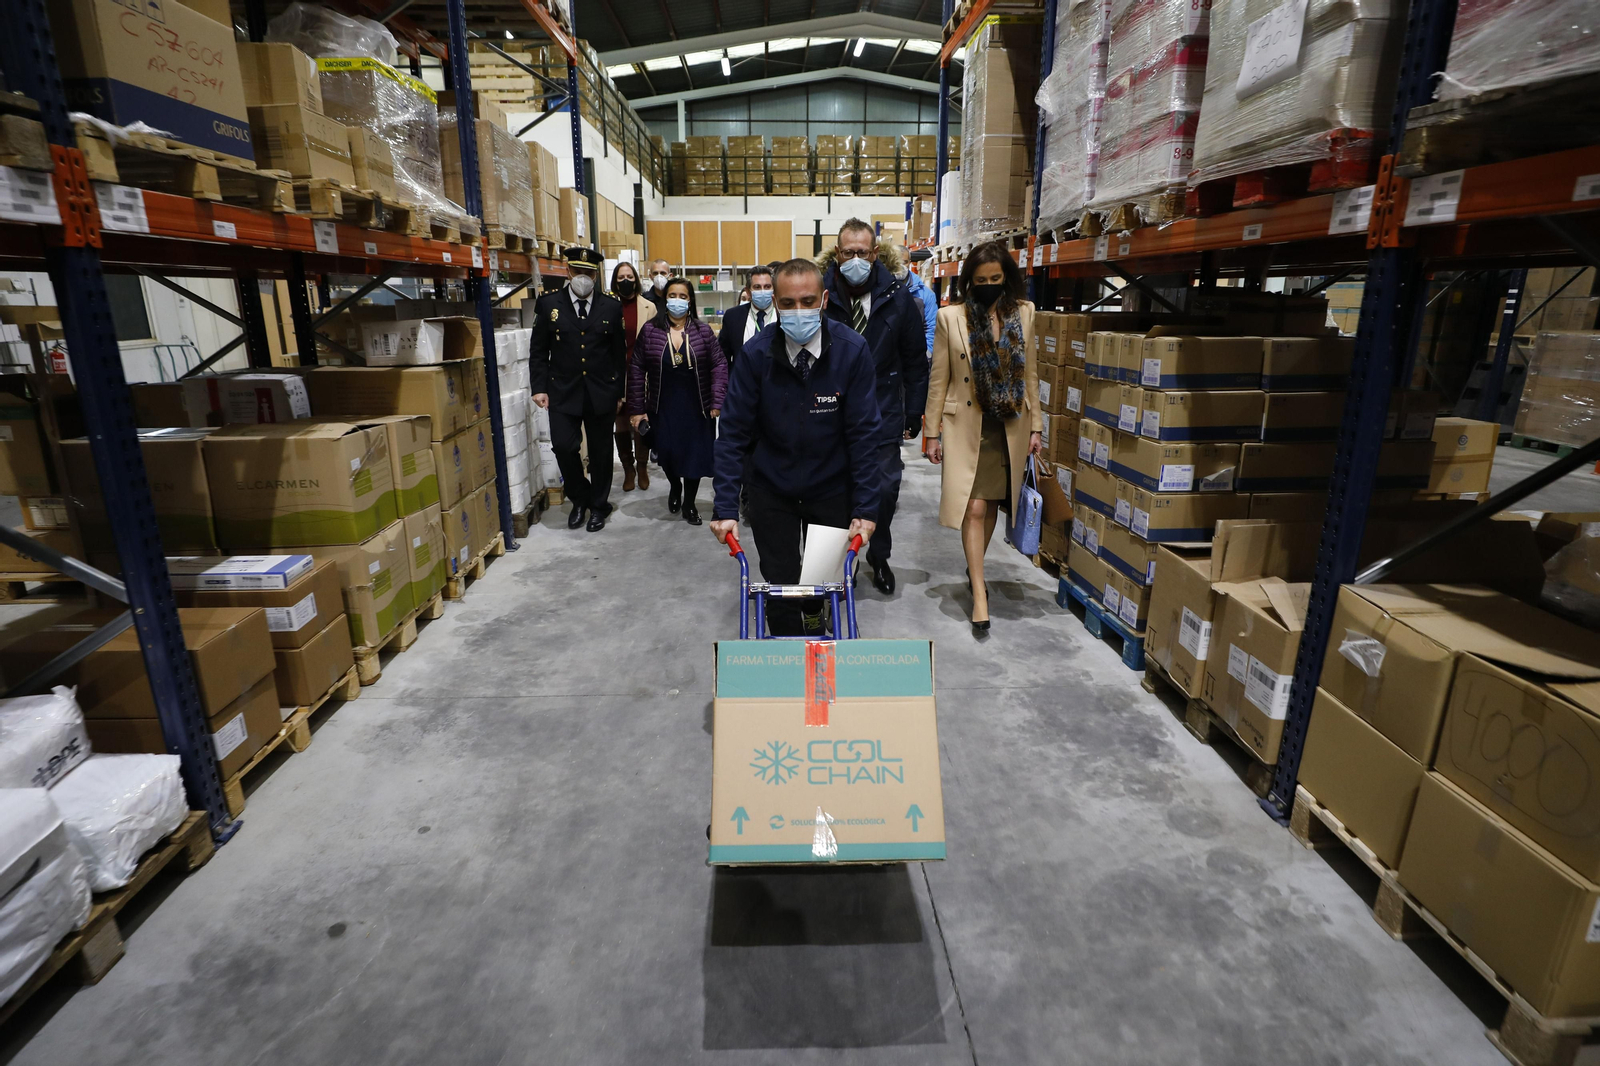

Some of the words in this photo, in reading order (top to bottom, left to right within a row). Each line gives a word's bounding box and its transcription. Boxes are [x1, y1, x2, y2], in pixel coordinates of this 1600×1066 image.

[324, 60, 352, 68] DACHSER
[212, 120, 250, 143] GRIFOLS
[1173, 147, 1194, 160] 8-9
[726, 655, 764, 665] FARMA
[846, 654, 920, 666] CONTROLADA
[807, 739, 903, 764] COOL
[807, 765, 904, 785] CHAIN
[790, 818, 826, 826] SOLUCI
[847, 817, 886, 826] ECOLÓGICA
